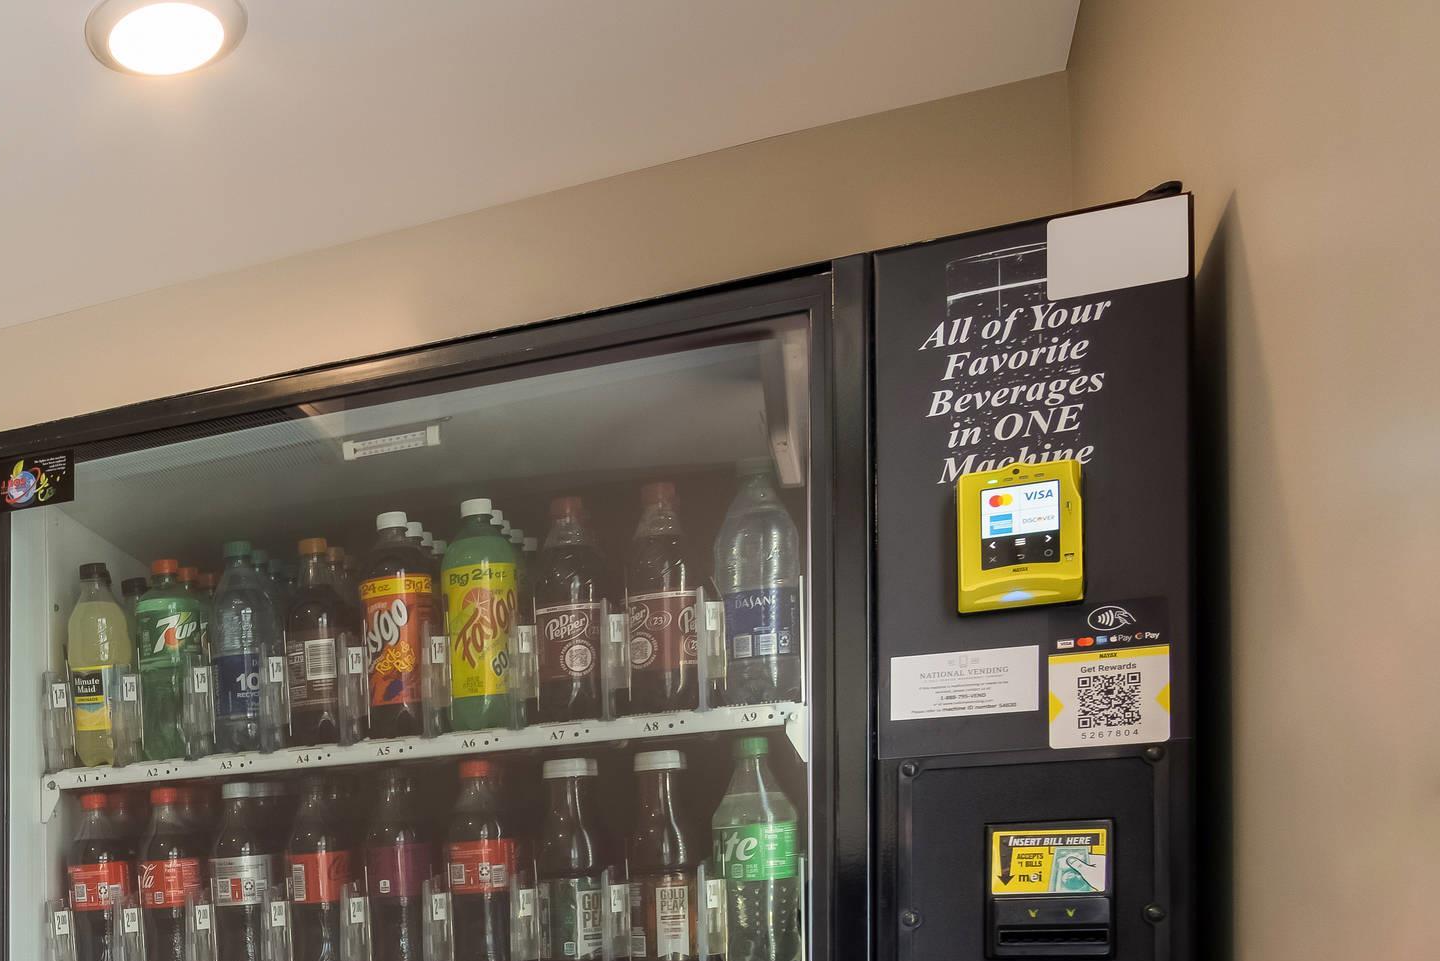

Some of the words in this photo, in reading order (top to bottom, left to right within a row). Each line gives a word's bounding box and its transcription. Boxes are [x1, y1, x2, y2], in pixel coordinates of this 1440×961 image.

[918, 317, 973, 351] All
[981, 307, 1024, 345] of
[1029, 301, 1112, 333] Your
[941, 336, 1090, 381] Favorite
[926, 371, 1105, 419] Beverages
[947, 422, 982, 449] in
[993, 404, 1085, 442] ONE
[1025, 489, 1054, 501] VISA
[1022, 515, 1055, 524] DISCOVER
[448, 572, 470, 587] Big
[471, 568, 494, 581] 24
[494, 570, 508, 578] oz
[378, 584, 392, 593] oz
[404, 578, 425, 593] Big
[559, 614, 576, 623] Dr
[652, 616, 664, 625] 23
[455, 588, 517, 670] Faygo
[545, 616, 586, 641] Pepper
[1118, 634, 1133, 643] Pay
[1145, 631, 1161, 640] Pay
[375, 647, 401, 676] Rock
[400, 640, 410, 652] &
[919, 669, 965, 680] NATIONAL
[967, 666, 1009, 675] VENDING
[1080, 666, 1096, 674] Get
[1098, 662, 1137, 672] Rewards
[74, 677, 100, 686] Minute
[77, 685, 97, 693] Maid
[740, 711, 758, 722] A9
[642, 721, 659, 733] A8
[549, 729, 565, 741] A7
[461, 738, 476, 749] A6
[376, 746, 391, 757] A5
[219, 760, 233, 770] A3
[295, 754, 310, 765] A4
[76, 773, 88, 783] A1
[146, 767, 159, 777] A2
[1008, 836, 1042, 847] INSERT
[1042, 837, 1064, 846] BILL
[1065, 836, 1092, 845] HERE
[1025, 860, 1042, 868] BILLS
[1018, 871, 1043, 883] mei
[660, 888, 685, 900] GOLD
[661, 900, 685, 912] PEAK
